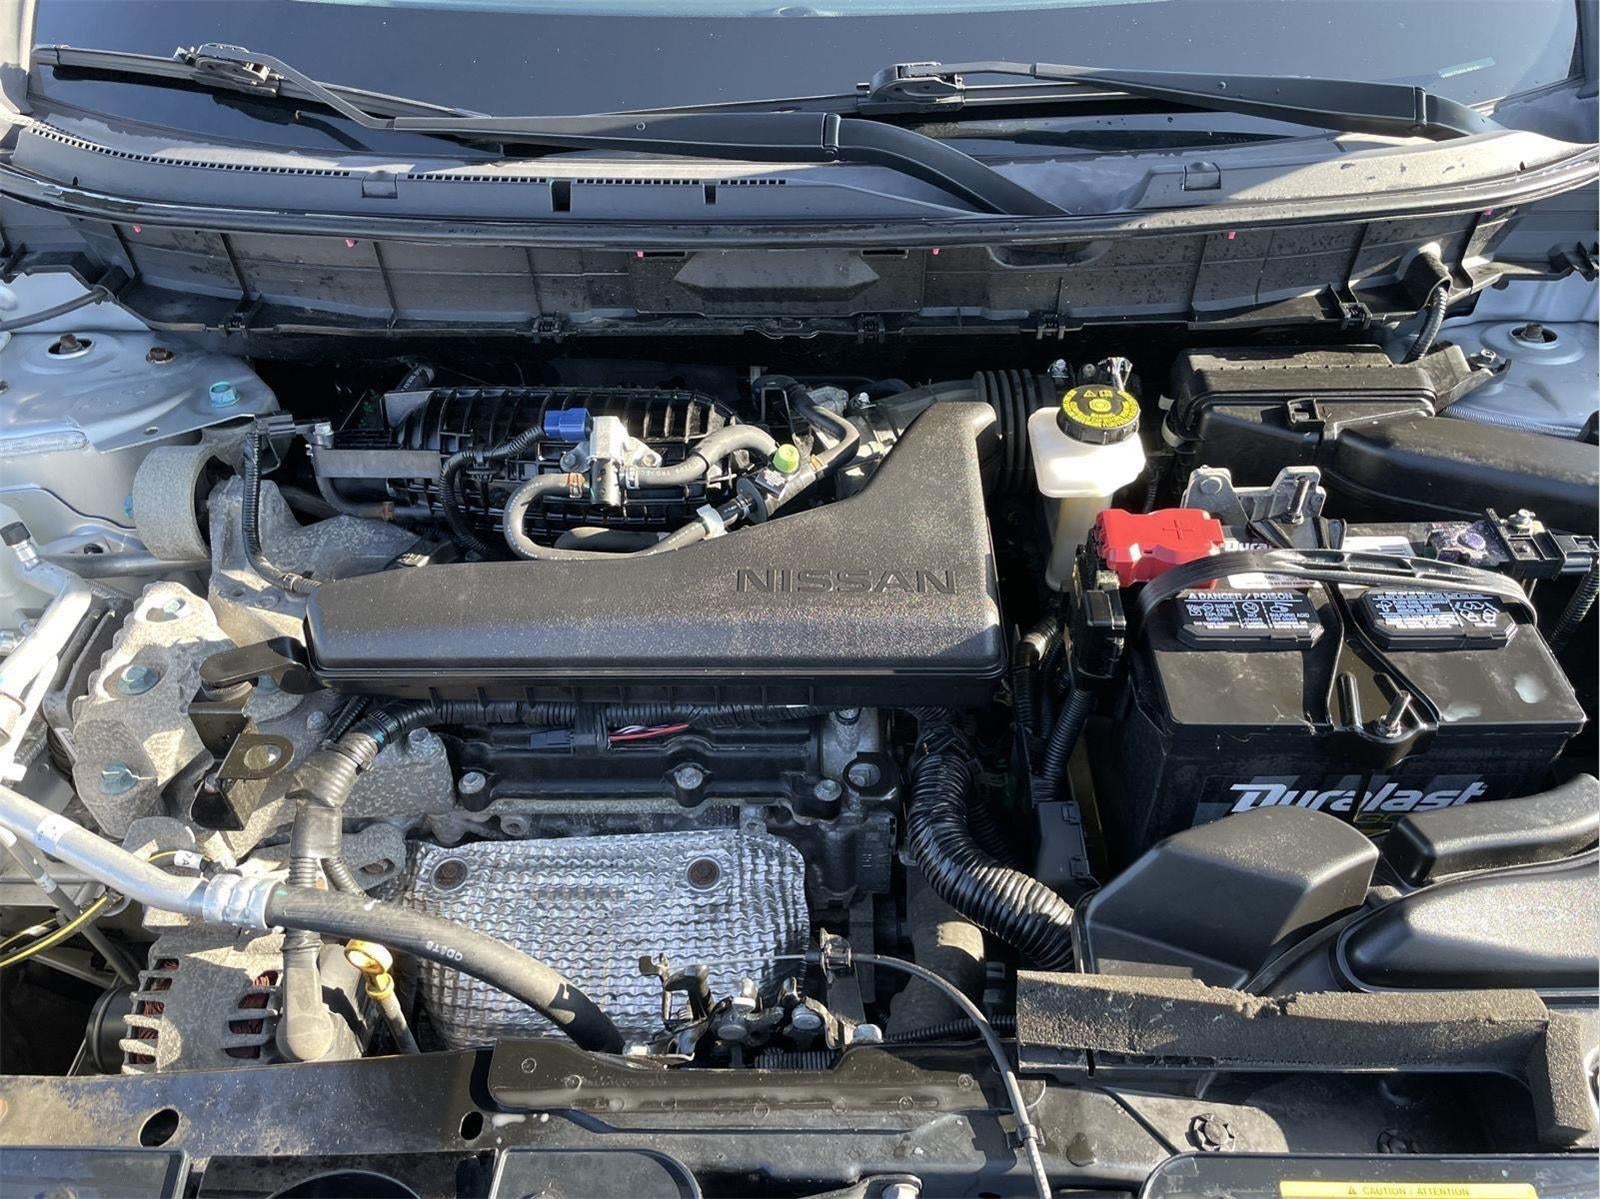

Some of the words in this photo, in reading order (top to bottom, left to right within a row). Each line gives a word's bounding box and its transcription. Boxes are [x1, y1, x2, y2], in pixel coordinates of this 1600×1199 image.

[736, 569, 956, 594] NISSAN
[1198, 592, 1243, 600] DANGER
[1254, 592, 1294, 600] POISON
[1230, 781, 1489, 813] Duralast
[1362, 1187, 1406, 1196] CAUTION
[1416, 1187, 1470, 1197] ATTENTION
